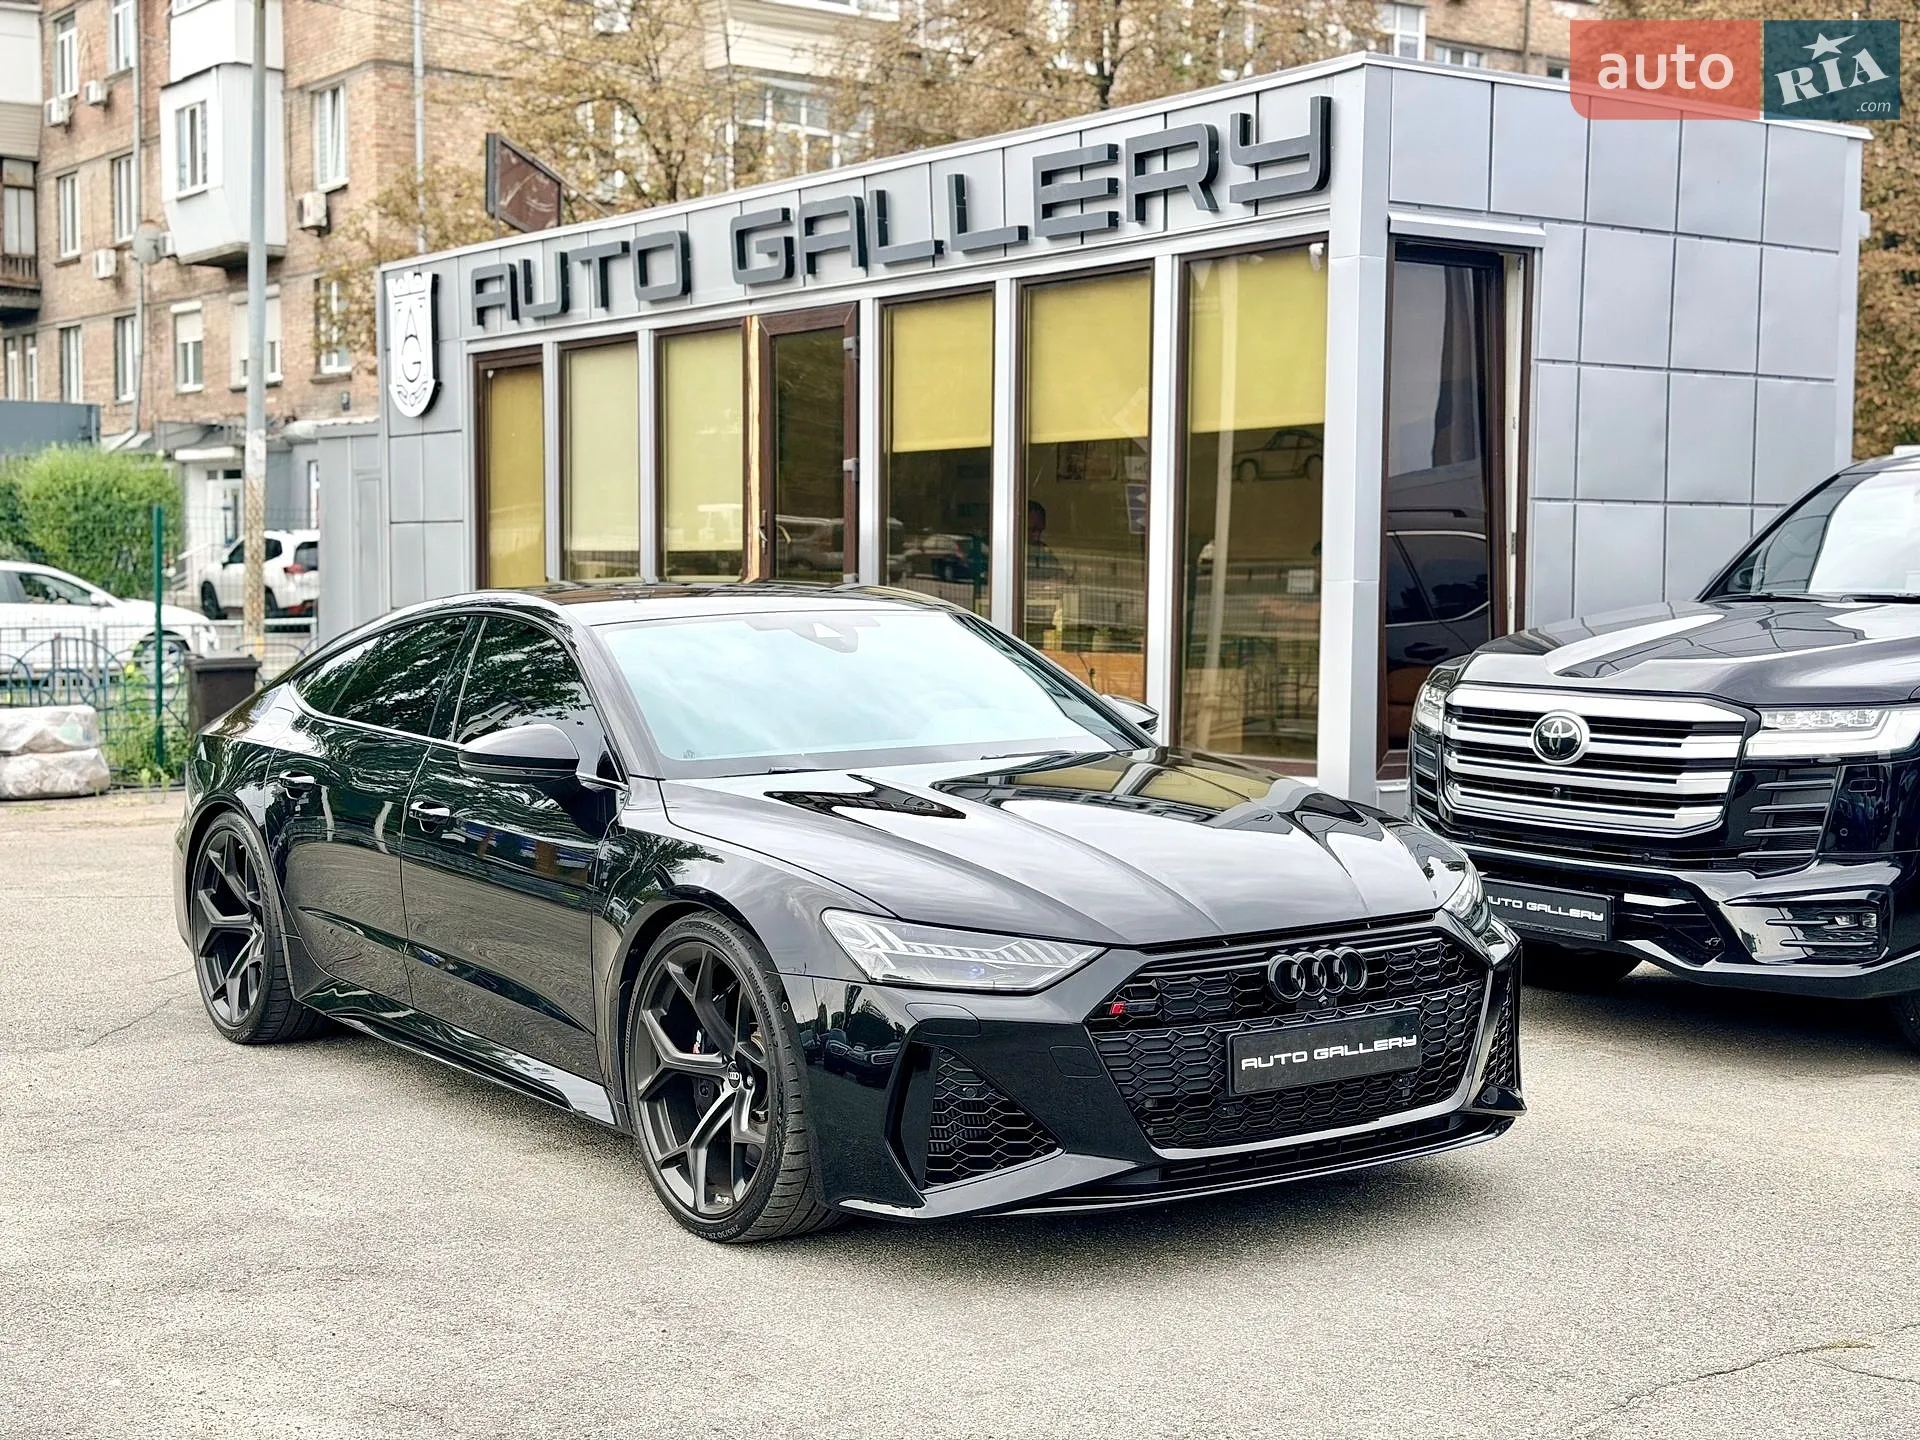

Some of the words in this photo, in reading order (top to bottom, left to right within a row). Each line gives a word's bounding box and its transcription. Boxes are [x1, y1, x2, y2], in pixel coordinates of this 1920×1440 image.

[470, 230, 692, 327] AUTO
[730, 95, 1332, 286] GALLERY
[1526, 902, 1603, 921] GALLERY
[1241, 1050, 1308, 1071] AUTO
[1313, 1034, 1418, 1060] GALLERY
